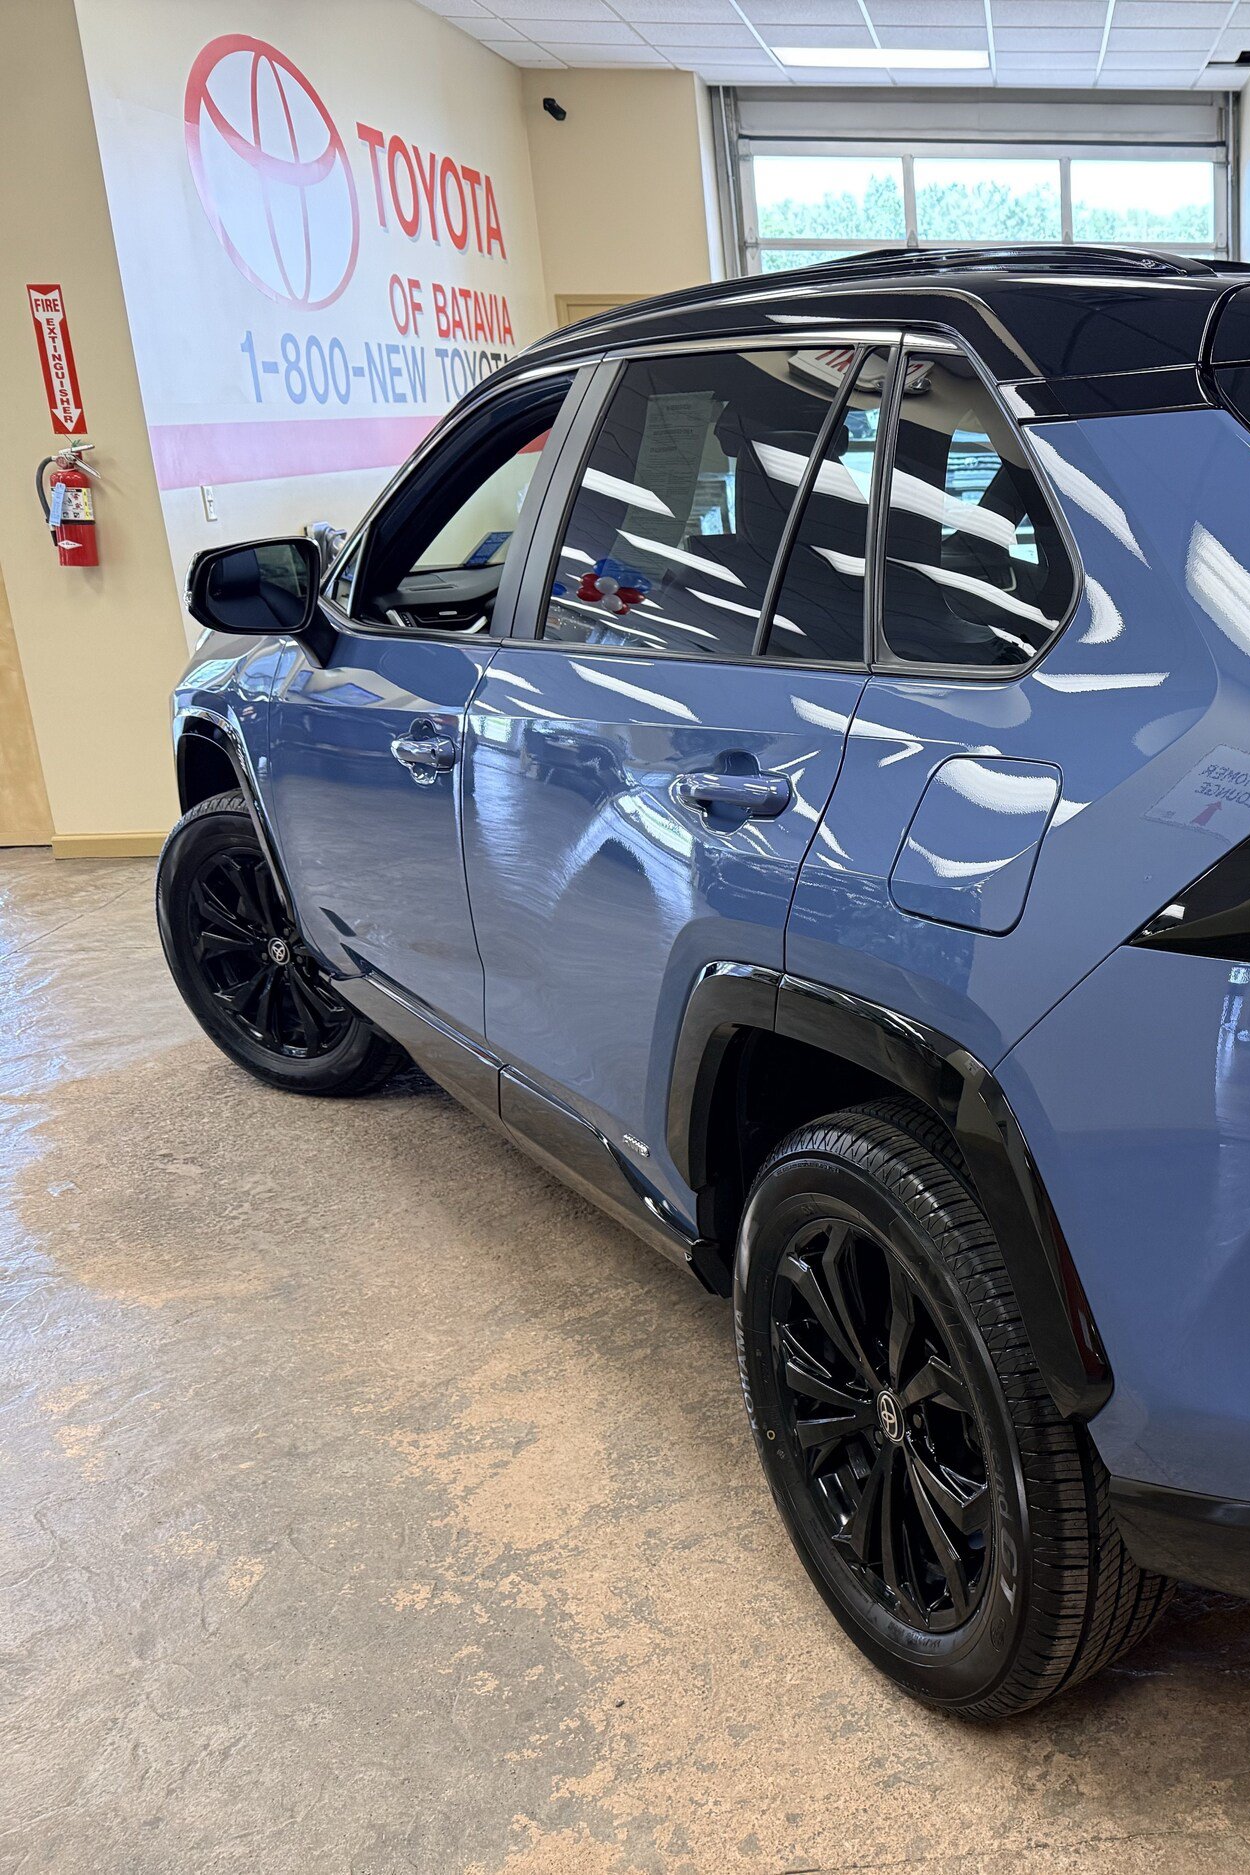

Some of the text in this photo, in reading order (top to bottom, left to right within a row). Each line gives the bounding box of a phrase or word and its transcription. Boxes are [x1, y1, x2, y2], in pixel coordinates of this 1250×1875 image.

[356, 121, 508, 261] TOYOTA
[34, 298, 61, 313] FIRE
[389, 273, 516, 346] OF BATAVIA
[46, 318, 74, 423] EXTINGUISHER
[240, 330, 427, 405] 1-800-NEW
